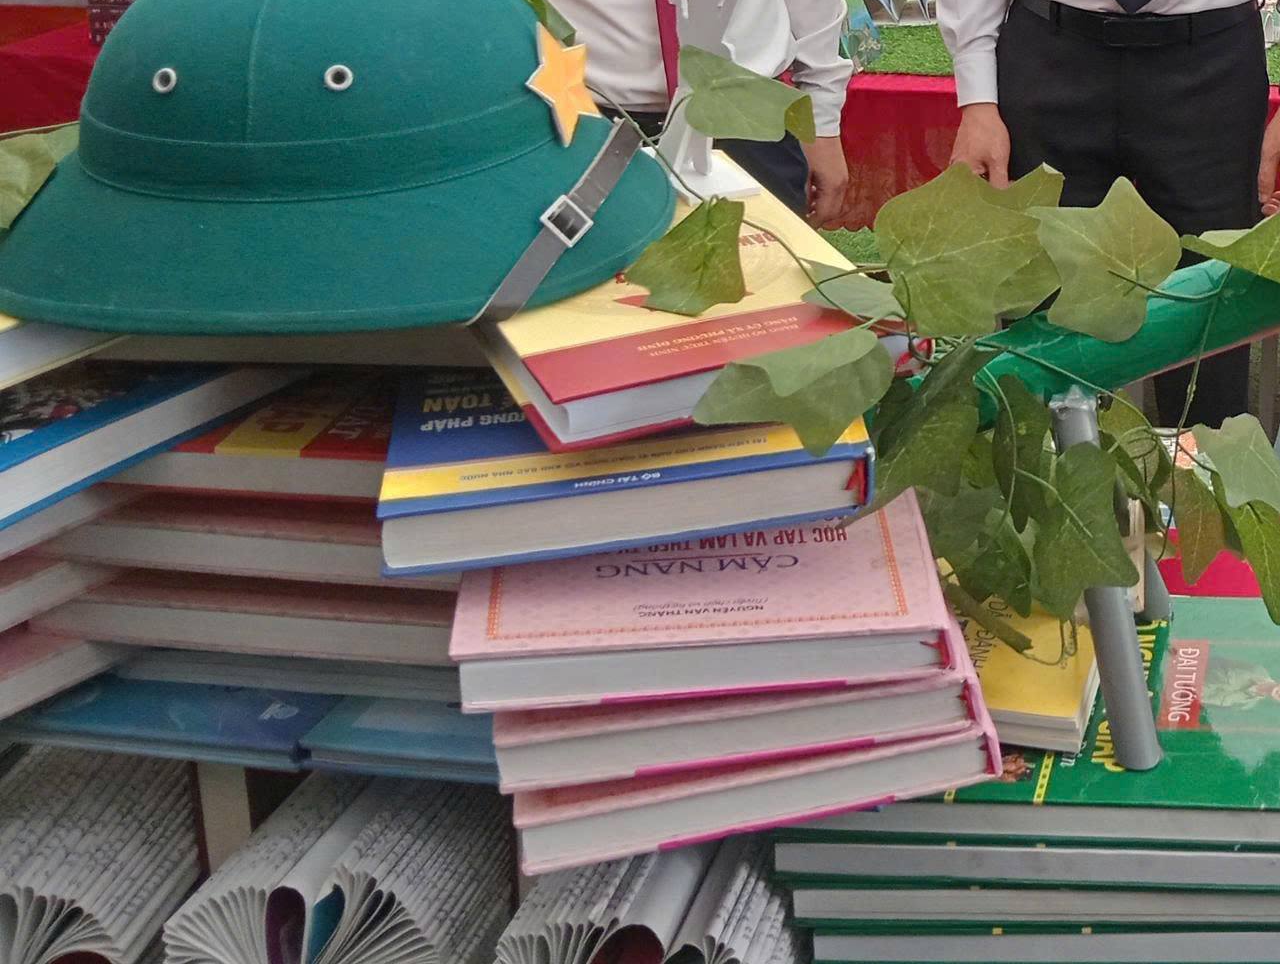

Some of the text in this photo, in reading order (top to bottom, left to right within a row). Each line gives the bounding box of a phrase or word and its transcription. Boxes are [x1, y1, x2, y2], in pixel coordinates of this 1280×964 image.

[596, 560, 703, 579] NANG
[1168, 647, 1200, 722] ĐẠI TƯỚNG
